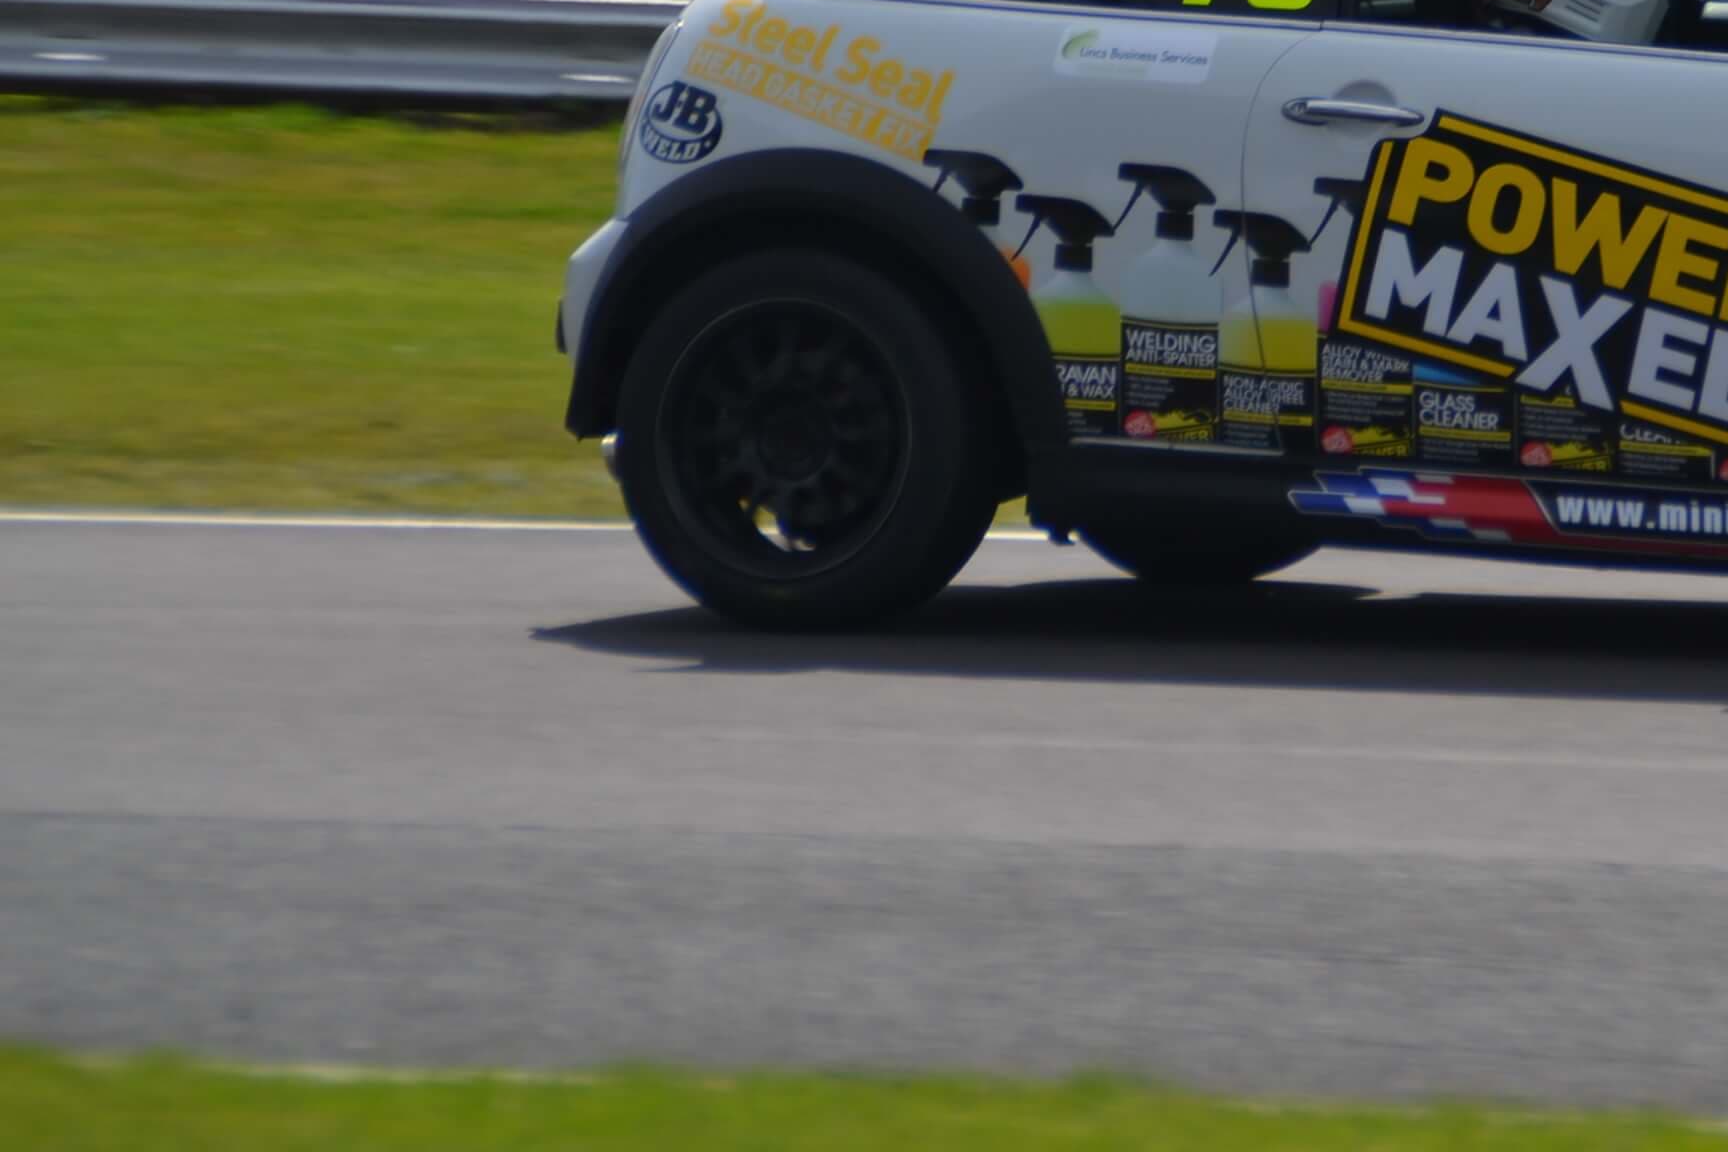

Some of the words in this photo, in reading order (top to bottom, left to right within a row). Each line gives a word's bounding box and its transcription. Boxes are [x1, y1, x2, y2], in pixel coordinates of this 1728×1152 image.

[1110, 48, 1157, 63] Business
[1160, 50, 1208, 66] Services
[833, 35, 954, 126] Seal
[640, 126, 698, 159] WELD
[1125, 328, 1217, 353] WELDING
[1125, 350, 1215, 367] ANTI-SPATTER
[1419, 390, 1476, 411] GLASS
[1419, 409, 1500, 430] CLEANER
